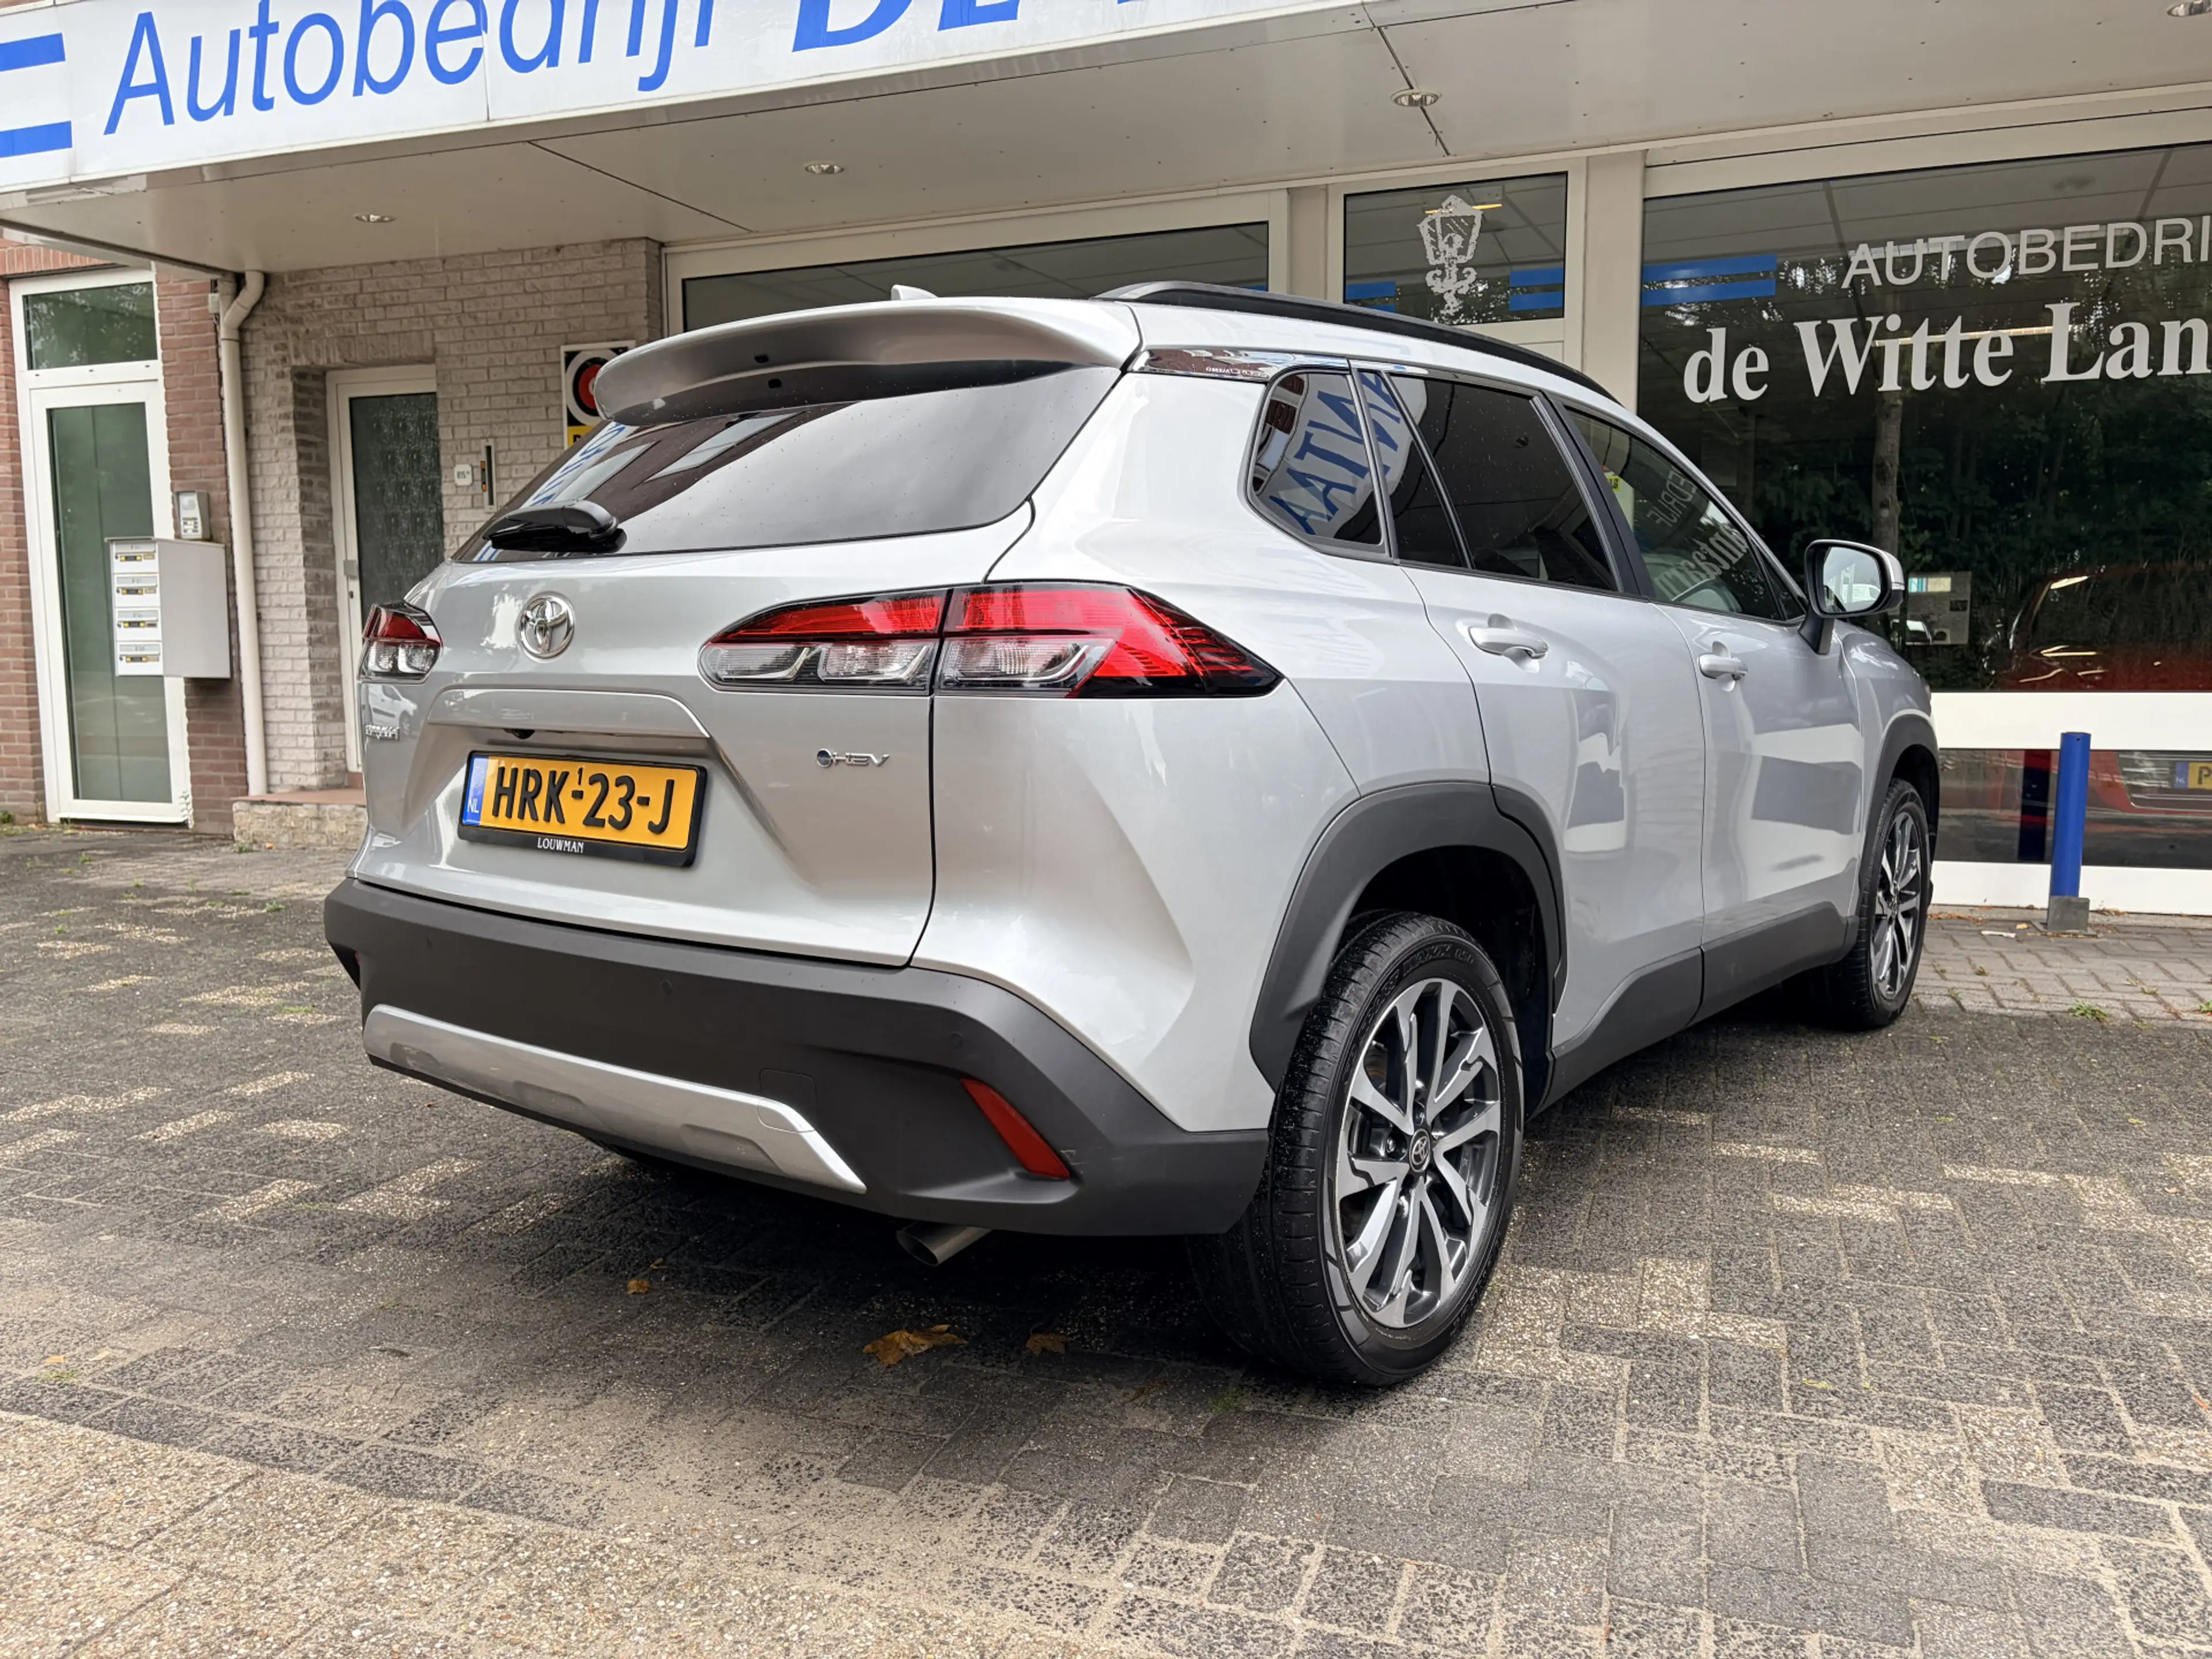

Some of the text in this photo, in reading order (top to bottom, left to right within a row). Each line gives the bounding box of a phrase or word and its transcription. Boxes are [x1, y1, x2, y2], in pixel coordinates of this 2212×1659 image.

[1841, 215, 2211, 289] AUTOBEDRI
[1683, 301, 2212, 403] de Witte Lan
[466, 766, 675, 835] NL HRK-23-J
[537, 837, 584, 854] LOUWMAN
